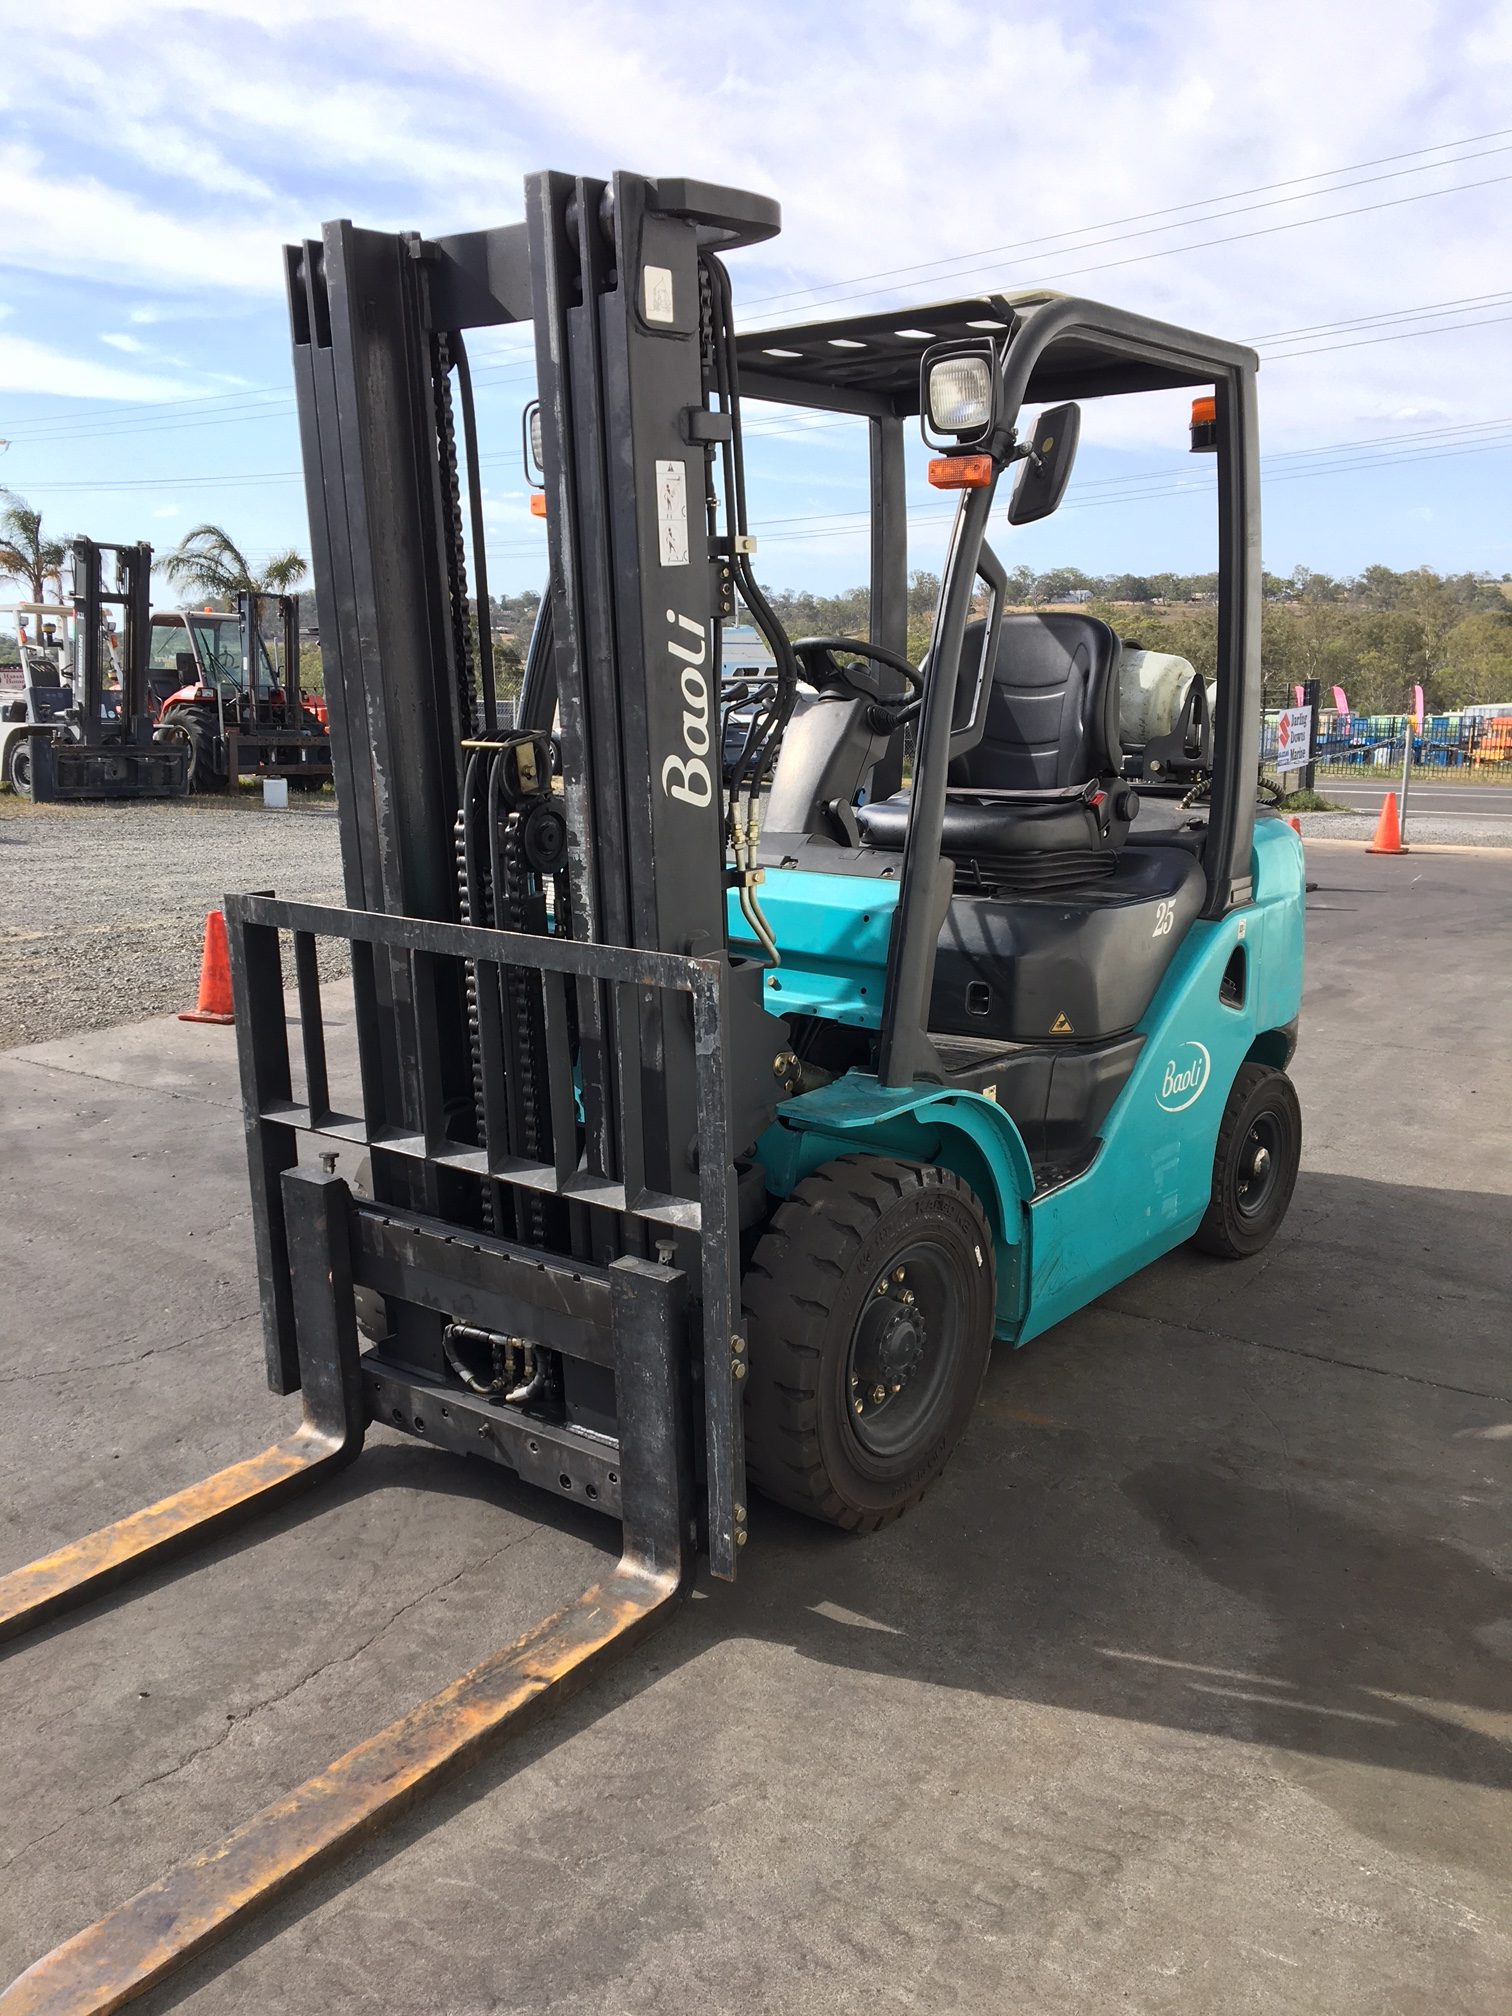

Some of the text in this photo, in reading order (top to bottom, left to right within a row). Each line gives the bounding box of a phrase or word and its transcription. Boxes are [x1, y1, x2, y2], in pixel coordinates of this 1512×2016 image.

[662, 608, 712, 808] Baoli
[1291, 712, 1308, 728] Darling
[1290, 730, 1306, 744] Downs
[1290, 746, 1306, 761] Marine
[1152, 899, 1176, 938] 25
[1162, 1058, 1202, 1098] Baoli
